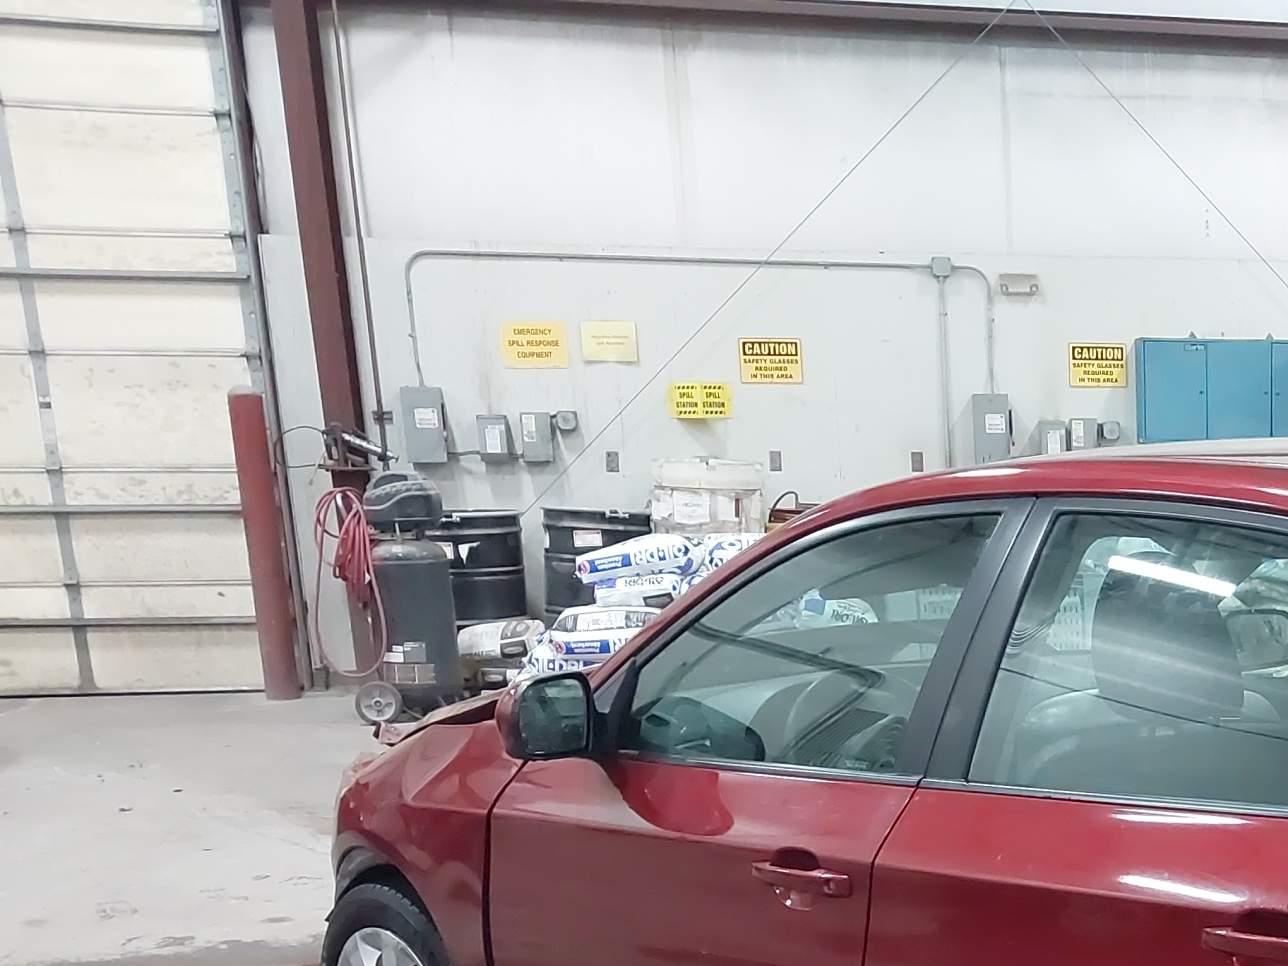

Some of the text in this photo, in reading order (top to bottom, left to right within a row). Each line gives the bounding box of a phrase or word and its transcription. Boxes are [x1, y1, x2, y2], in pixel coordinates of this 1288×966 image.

[508, 339, 560, 347] SPILL RESPONSE
[744, 343, 796, 355] CAUTION
[517, 351, 552, 359] EQUIPMENT
[1074, 347, 1122, 360] CAUTION
[679, 391, 694, 399] SPILL
[705, 391, 721, 399] SPILL
